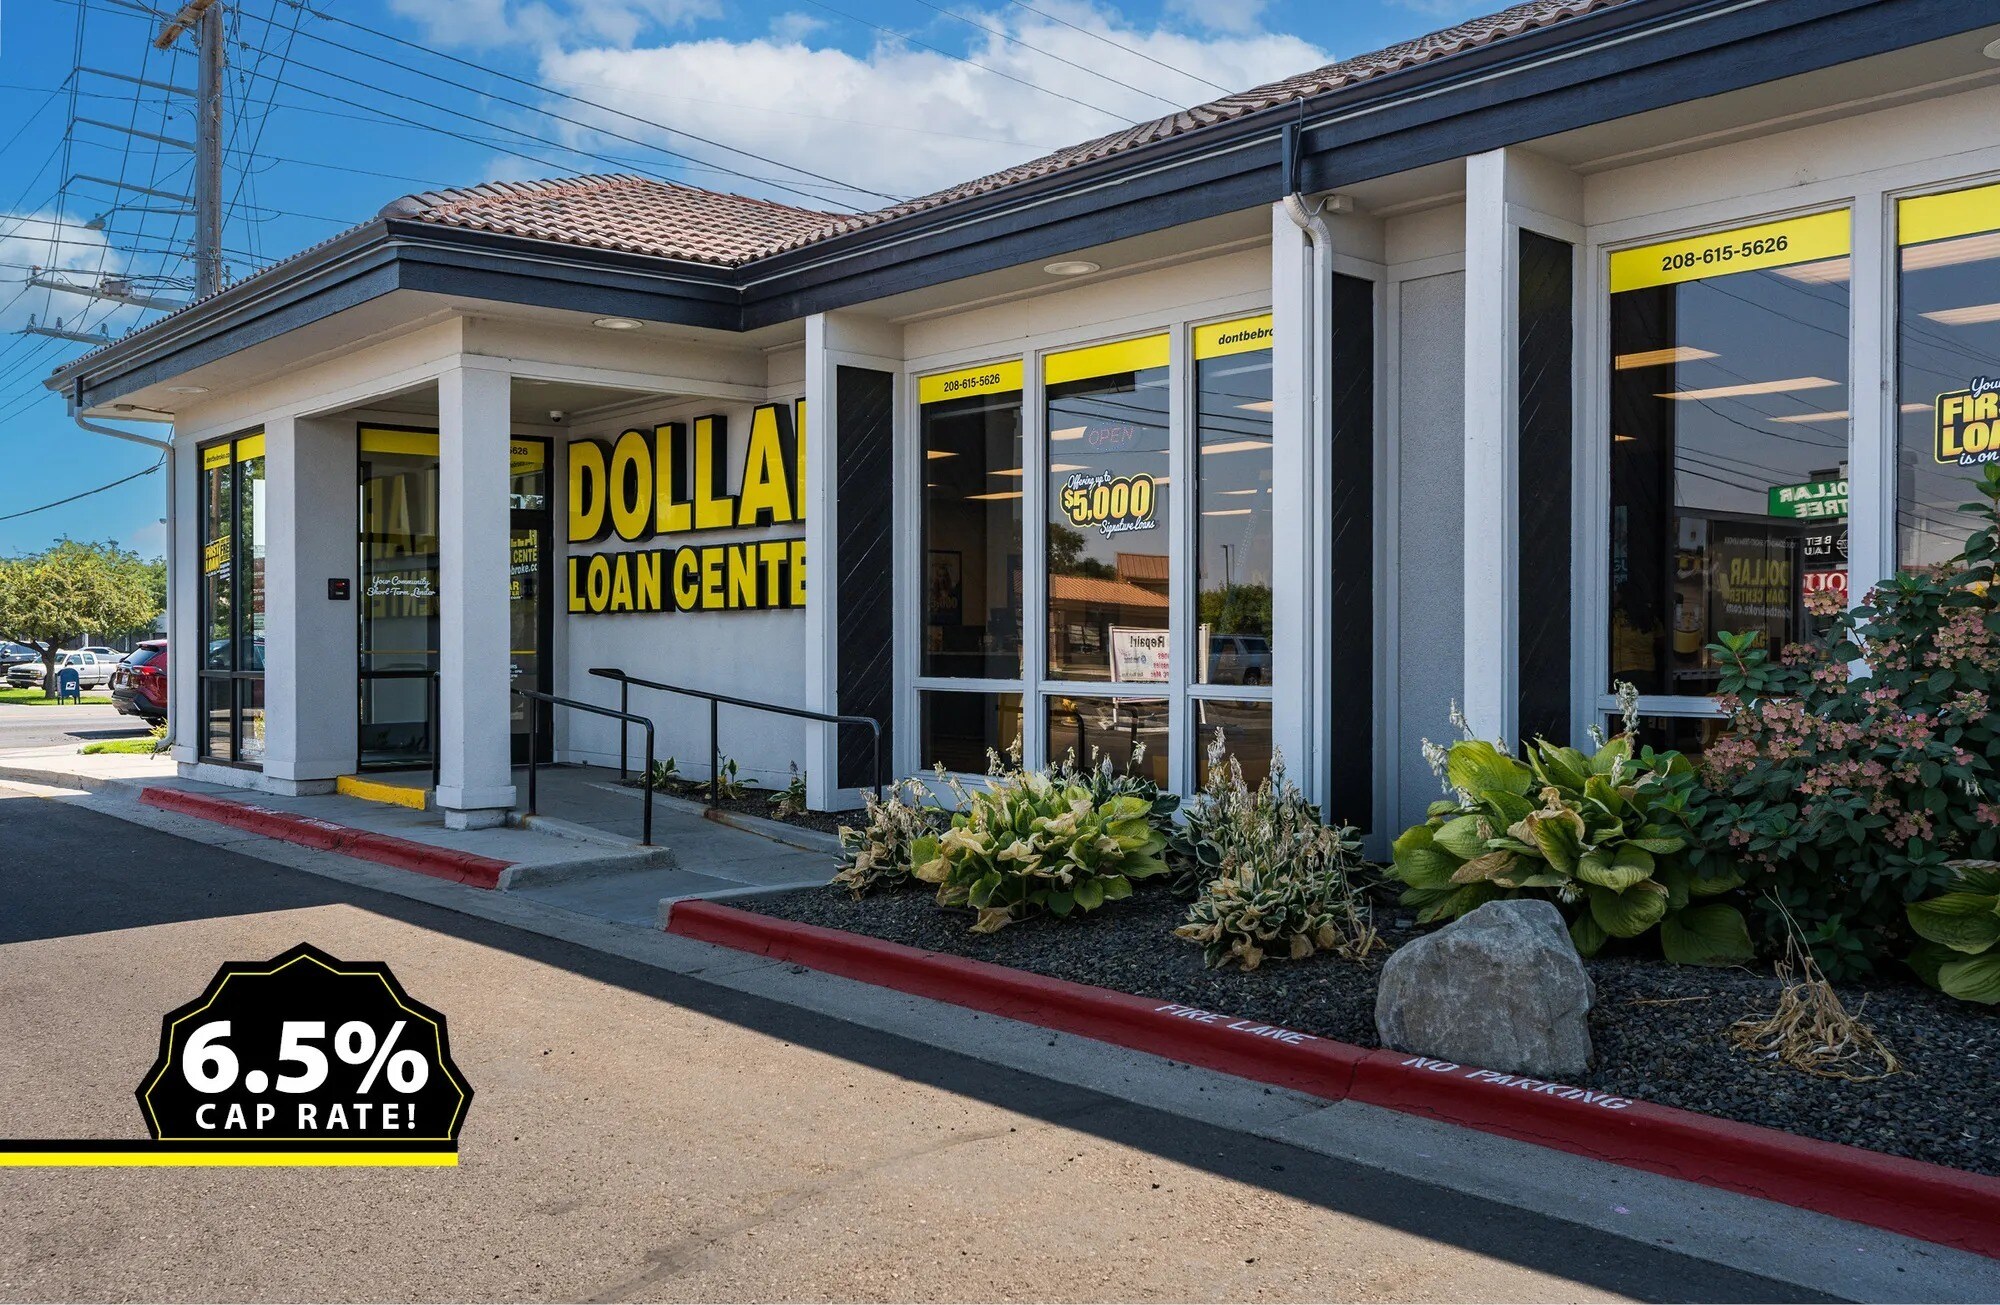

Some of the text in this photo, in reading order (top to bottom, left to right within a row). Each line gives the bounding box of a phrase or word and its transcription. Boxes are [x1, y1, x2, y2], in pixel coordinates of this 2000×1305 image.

[1661, 234, 1788, 272] 208-615-5626
[1218, 328, 1273, 345] dontbebro
[943, 373, 1000, 393] 208-615-5626
[1972, 378, 2000, 398] You
[1943, 392, 2000, 425] FIR
[1087, 425, 1134, 447] OPEN
[510, 446, 528, 456] 626
[1960, 451, 1999, 465] is on
[567, 398, 806, 544] DOLLA
[1064, 480, 1150, 521] $5,000
[1100, 518, 1135, 539] Signature
[513, 548, 538, 564] CENTE
[372, 575, 431, 590] Your Community
[567, 540, 806, 614] LOAN CENTE
[366, 586, 410, 598] Short-Term
[1155, 1003, 1318, 1046] FIRE LANE
[1401, 1056, 1633, 1110] NO PARKING
